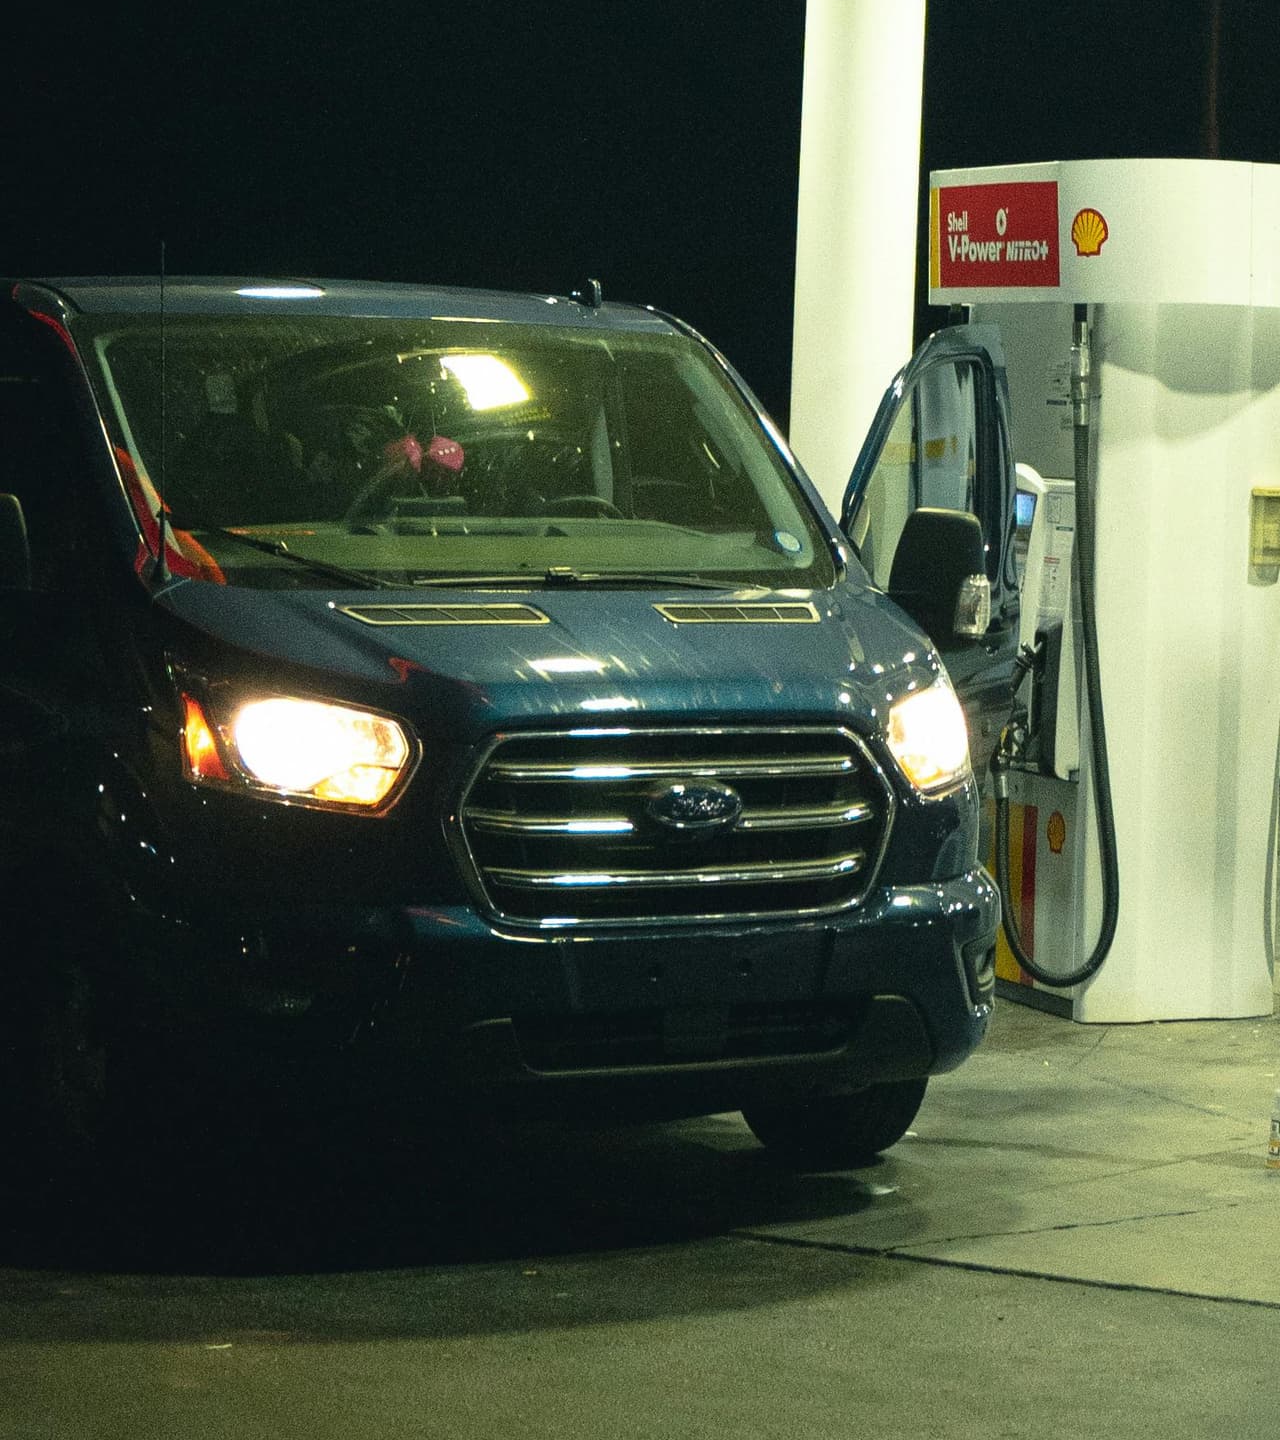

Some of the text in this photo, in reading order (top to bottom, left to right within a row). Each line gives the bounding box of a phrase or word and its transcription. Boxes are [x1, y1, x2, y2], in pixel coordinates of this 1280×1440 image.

[948, 211, 967, 232] Shell
[948, 235, 1049, 262] V-Power NITRO+
